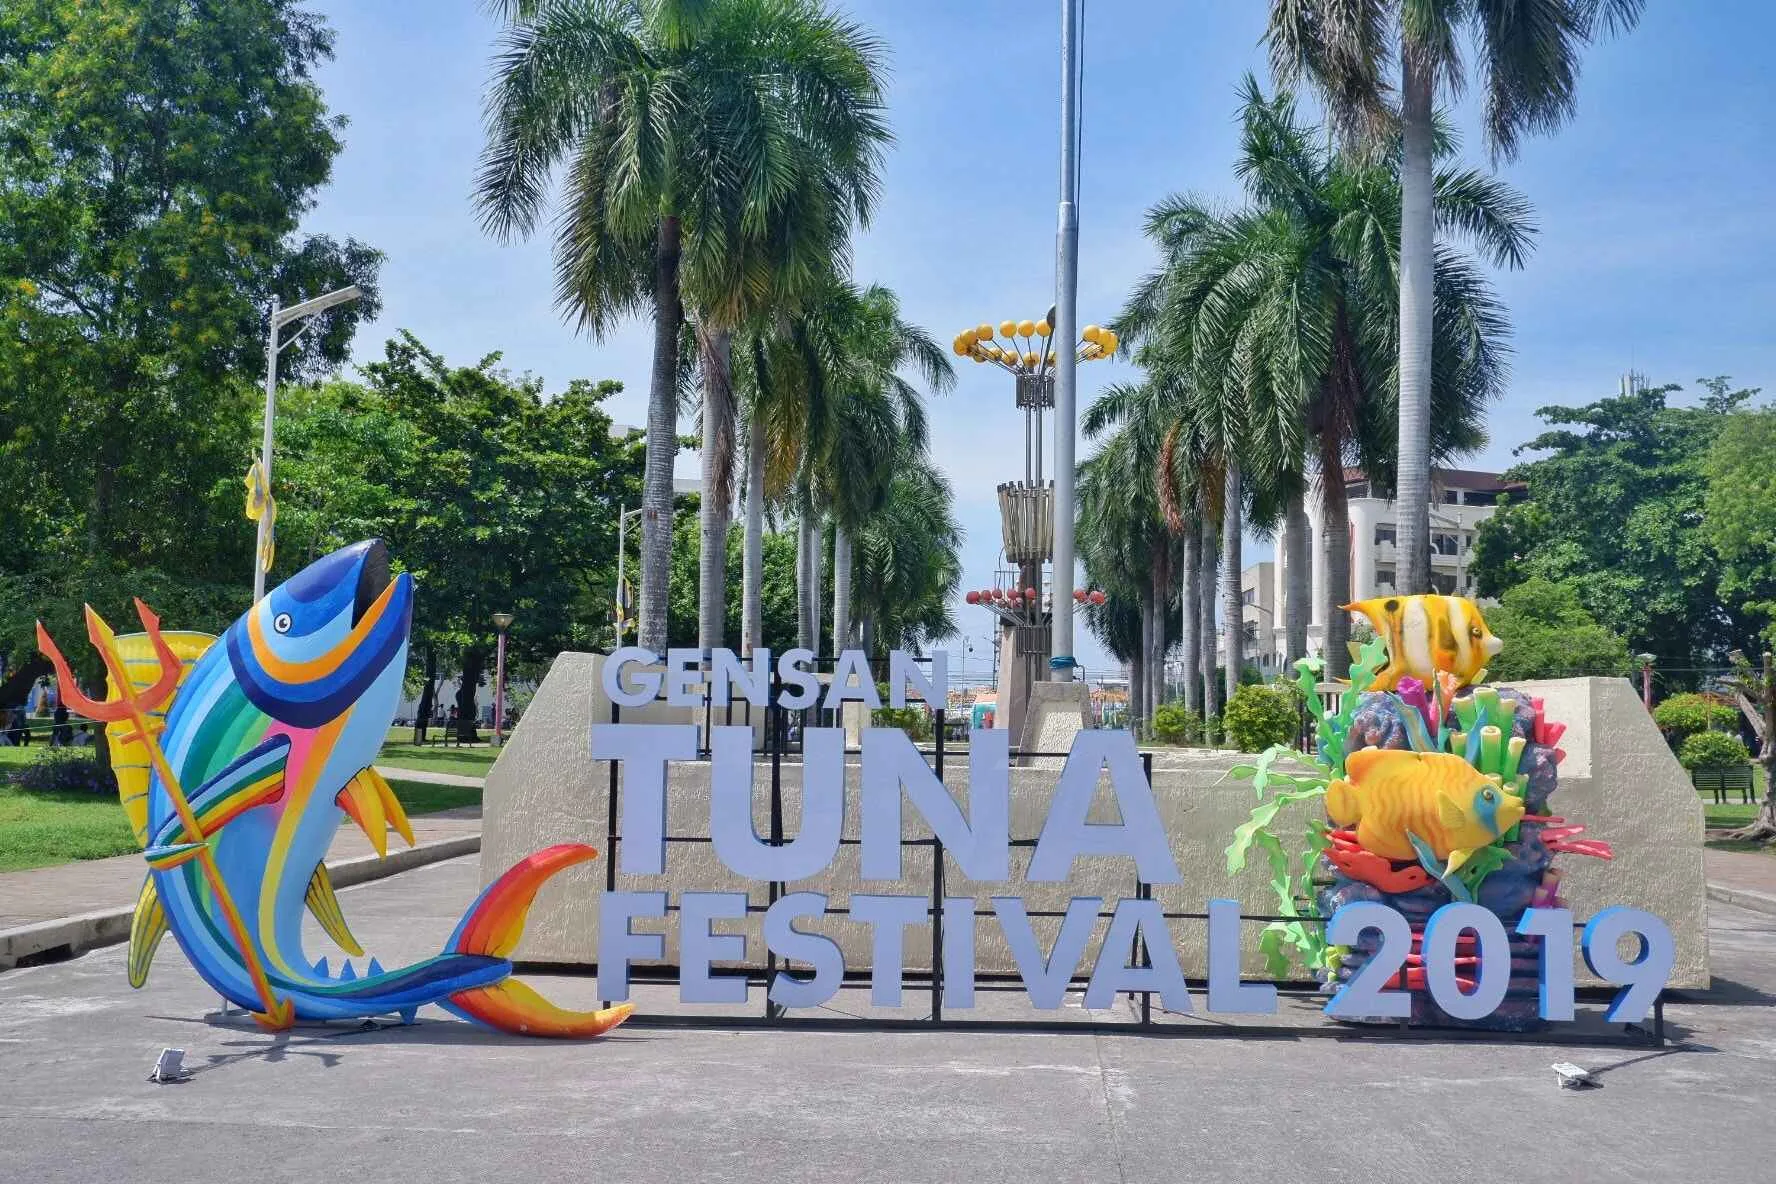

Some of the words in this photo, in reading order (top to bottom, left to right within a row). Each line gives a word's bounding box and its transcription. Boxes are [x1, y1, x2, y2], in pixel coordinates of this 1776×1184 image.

[601, 647, 948, 710] GENSAN
[592, 724, 1184, 884] TUNA
[597, 891, 1278, 1014] FESTIVAL
[1324, 901, 1676, 1023] 2019
